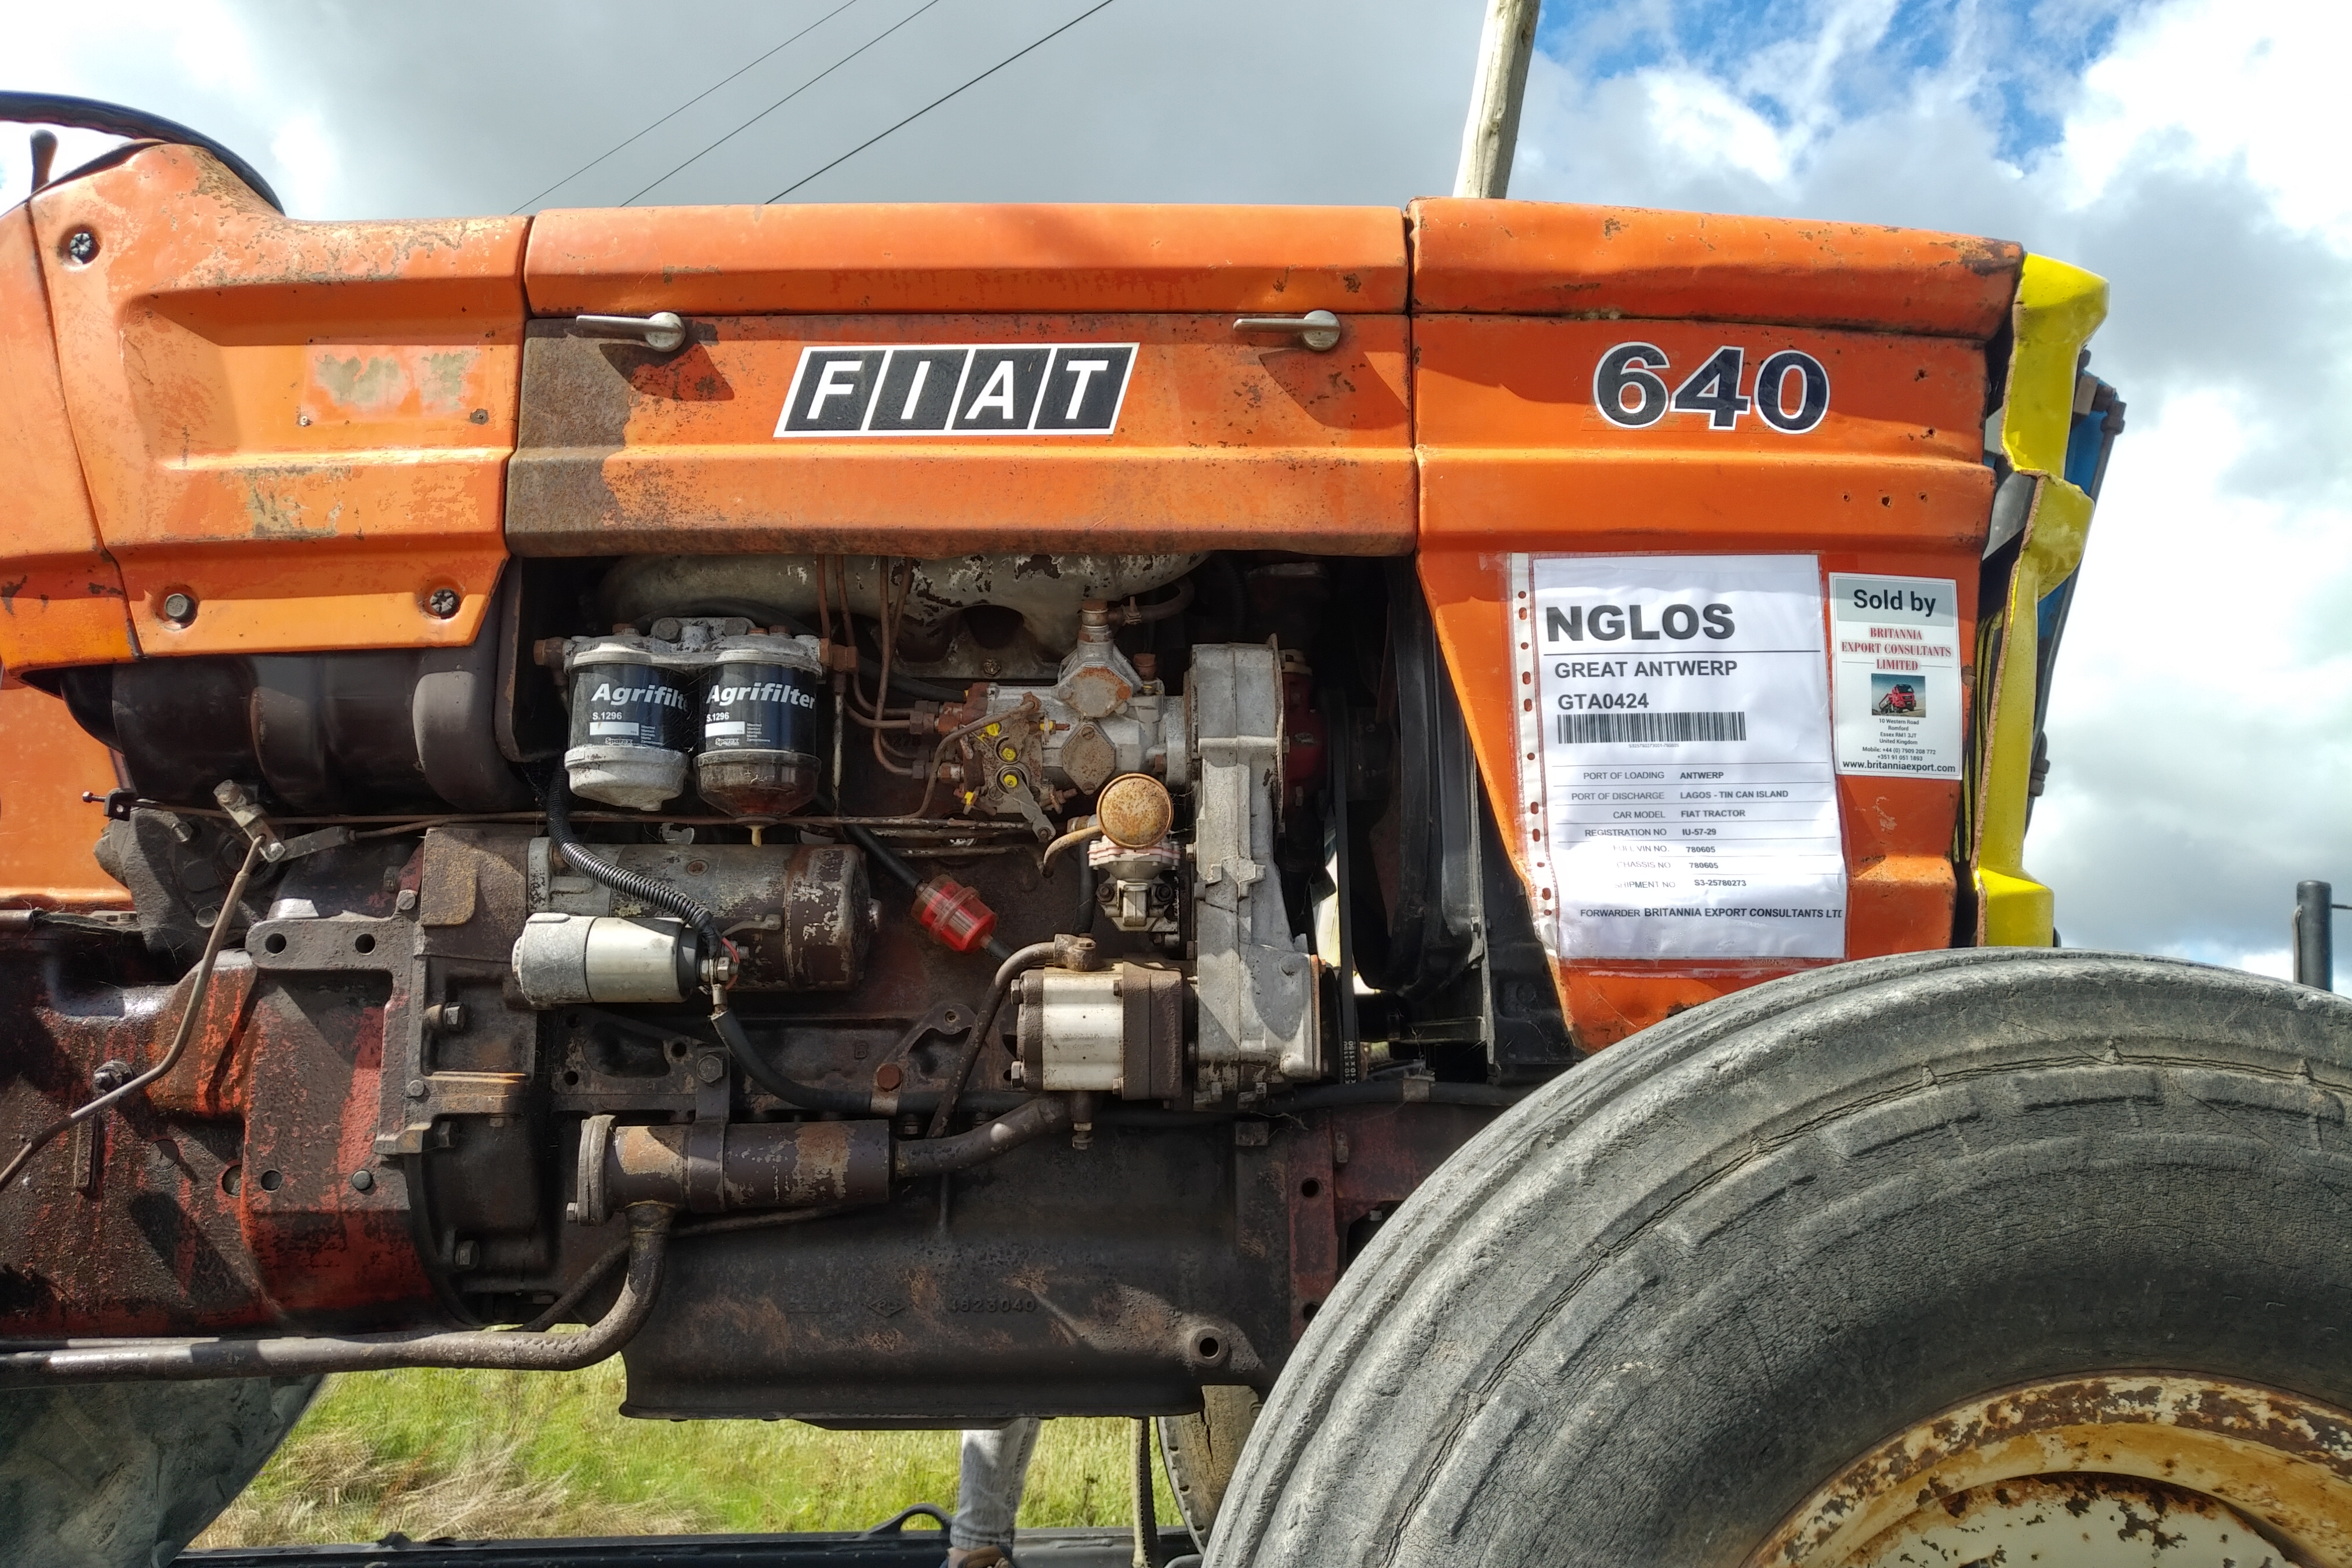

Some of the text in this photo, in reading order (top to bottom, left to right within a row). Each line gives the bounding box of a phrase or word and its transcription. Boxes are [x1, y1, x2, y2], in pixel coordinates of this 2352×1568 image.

[806, 360, 1109, 419] FIAT
[1593, 341, 1830, 434] 640
[1854, 589, 1936, 617] Sold by
[1546, 603, 1735, 642] NGLOS
[1870, 627, 1923, 640] BRITANNIA
[1842, 641, 1951, 657] EXPORT CONSULTANTS
[1555, 660, 1737, 678] GREAT ANTWERP
[1876, 659, 1918, 671] LIMITED
[706, 682, 815, 709] Agrifilter
[1558, 693, 1649, 710] GTA0424
[593, 712, 622, 720] S.1296
[706, 712, 729, 722] S.1296
[715, 738, 739, 746] Sparex
[1843, 760, 1955, 772] www.britanniaexport.com
[1583, 772, 1608, 780] PORT
[1625, 771, 1665, 779] LOADING
[1680, 771, 1724, 779] ANTWERP
[1571, 792, 1596, 800] PORT
[1598, 792, 1610, 800] OF
[1612, 792, 1665, 800] DISCHARGE
[1680, 791, 1711, 799] LAGOS
[1613, 811, 1632, 819] CAR
[1681, 810, 1701, 818] FIAT
[1703, 810, 1745, 818] TRACTOR
[1585, 829, 1651, 837] REGISTRATION
[1580, 909, 1640, 917] FORWARDER
[1644, 908, 1702, 917] BRITANNIA
[1704, 908, 1747, 917] EXPORT
[1750, 908, 1824, 918] CONSULTANTS
[1350, 1068, 1356, 1077] 10
